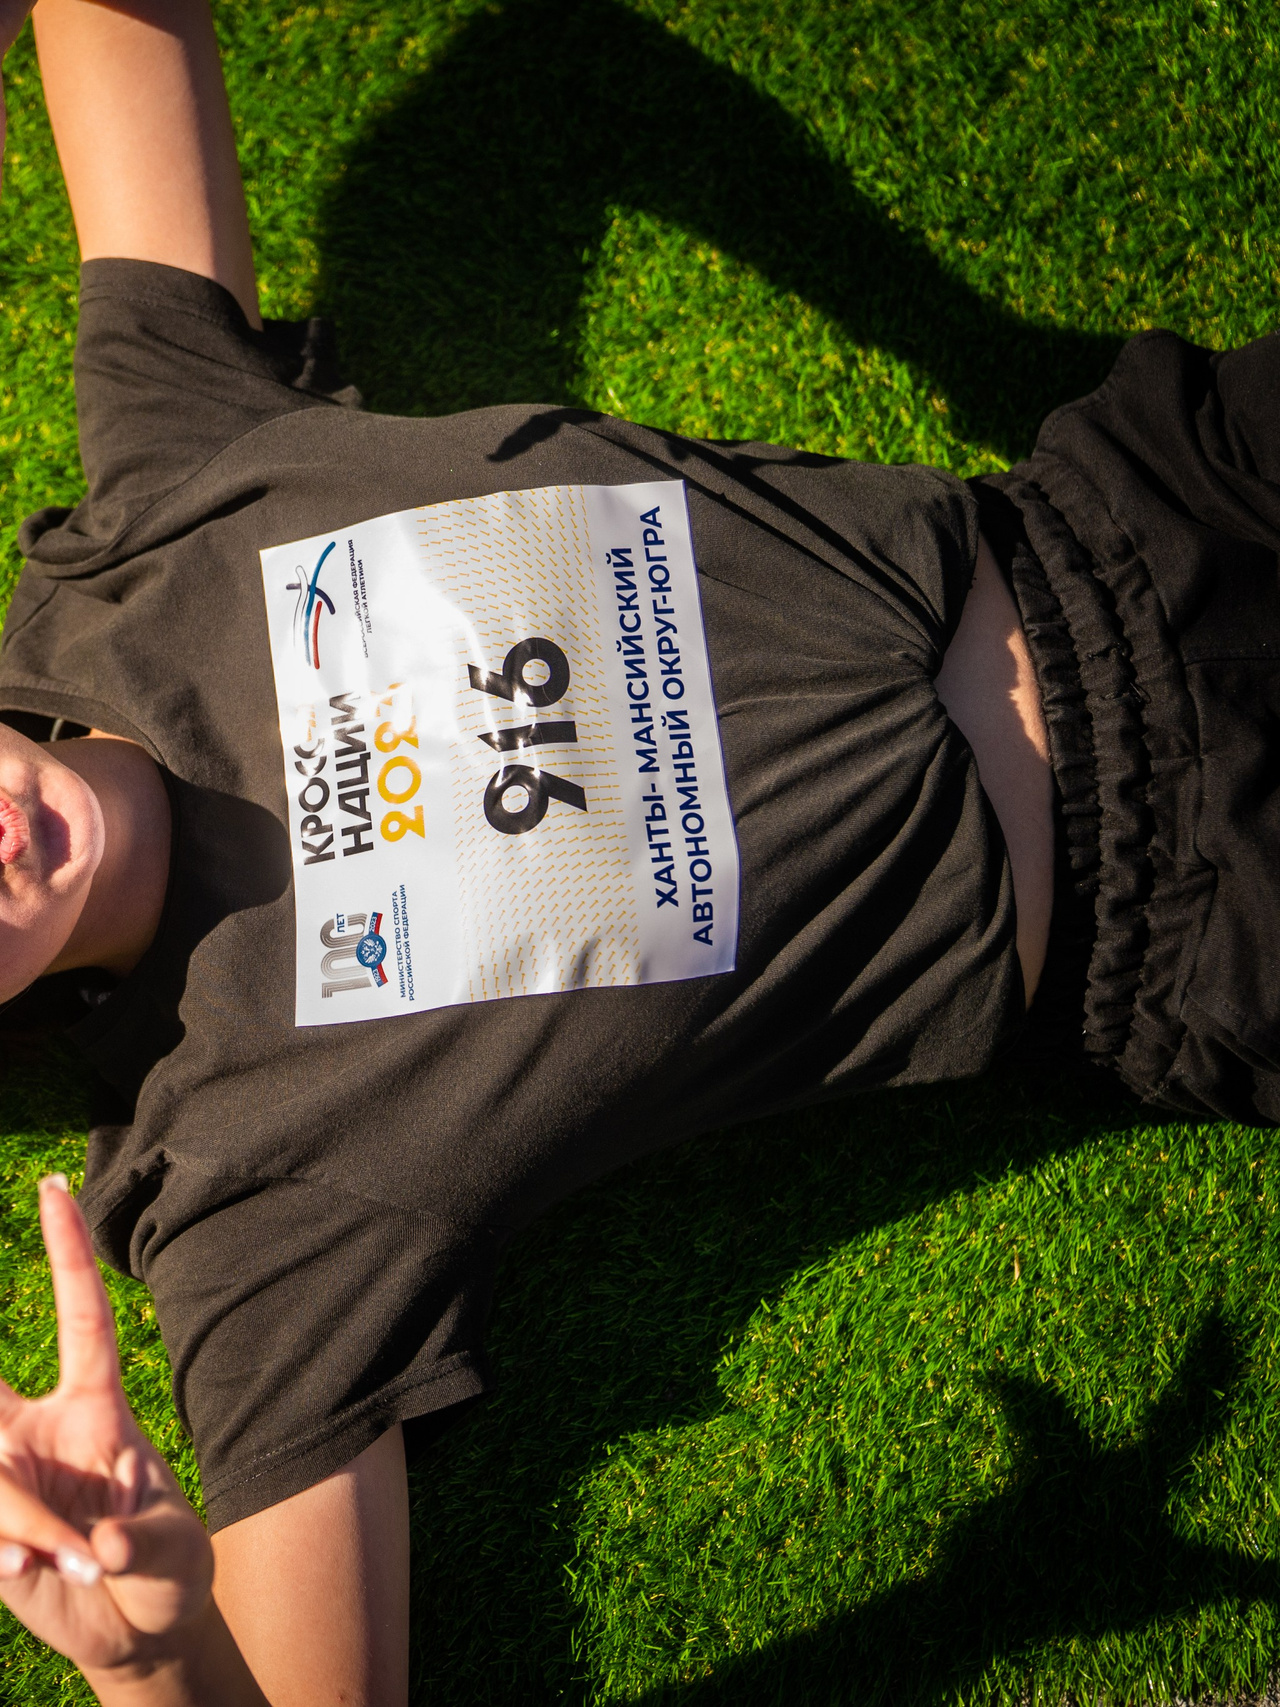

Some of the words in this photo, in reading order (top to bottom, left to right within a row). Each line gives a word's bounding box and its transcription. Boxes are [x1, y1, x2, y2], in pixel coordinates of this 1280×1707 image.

[348, 539, 358, 589] ФЕДЕРАЦИЯ
[357, 559, 367, 600] АТЛЕТИКИ
[361, 602, 372, 633] ЛЕГКОЙ
[639, 505, 685, 700] ОКРУГ-ЮГРА
[605, 548, 660, 773] МАНСИЙСКИЙ
[467, 637, 587, 835] 916
[293, 738, 336, 865] КРОСС
[329, 692, 375, 857] НАЦИИ
[642, 782, 679, 909] ХАНТЫ-
[661, 709, 713, 946] АВТОНОМНЫЙ
[336, 913, 345, 933] ЛЕТ
[369, 916, 377, 932] 2023
[399, 884, 410, 938] ФЕДЕРАЦИИ
[394, 927, 406, 998] МИНИСТЕРСТВО
[403, 940, 415, 1001] РОССИЙСКОЙ
